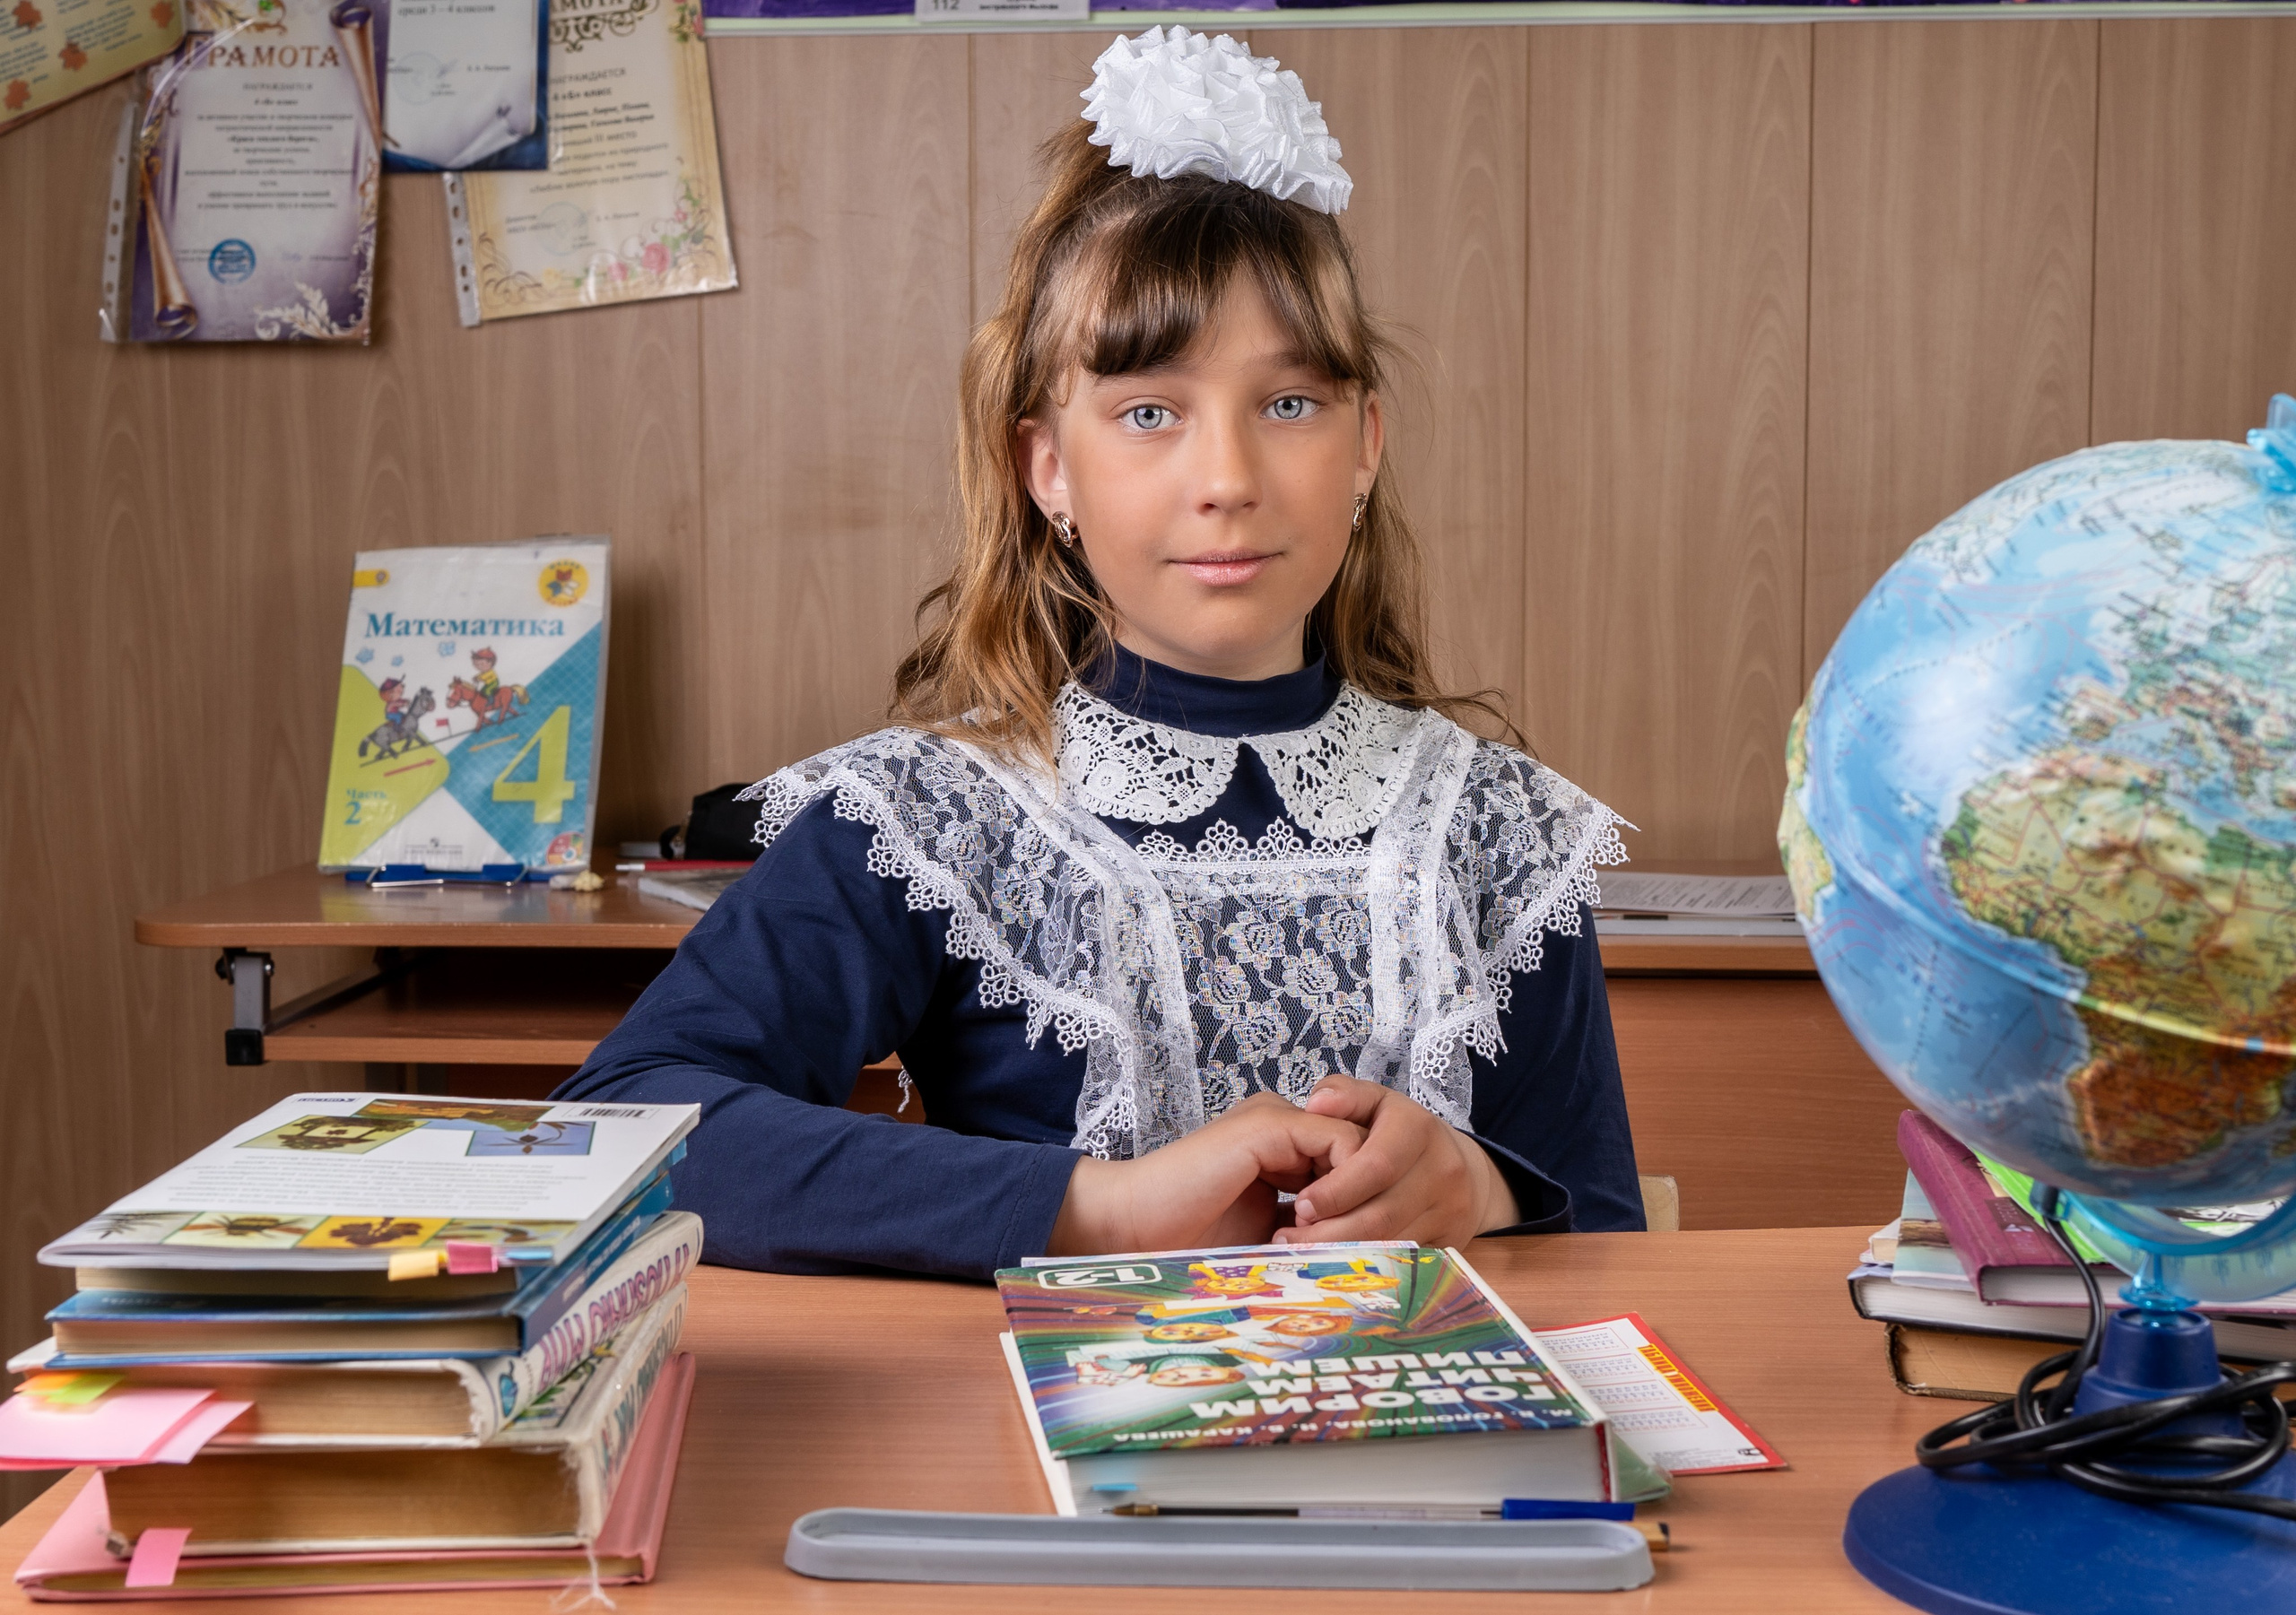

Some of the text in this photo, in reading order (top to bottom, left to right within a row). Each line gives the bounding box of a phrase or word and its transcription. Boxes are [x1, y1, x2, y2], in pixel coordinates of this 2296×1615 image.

[185, 34, 341, 68] ГРАМОТА
[365, 612, 565, 638] Математика
[491, 705, 576, 824] 4
[344, 801, 362, 826] 2
[1054, 1267, 1146, 1286] 1-2
[1248, 1350, 1526, 1378] ПИШЕМ
[1247, 1367, 1544, 1395] ЧИТАЕМ
[1188, 1385, 1557, 1419] ГОВОРИМ
[1540, 1408, 1574, 1418] М.
[1292, 1421, 1319, 1432] Н.
[1326, 1411, 1505, 1429] ГОЛОВАНОВА,
[1112, 1426, 1254, 1443] КАРАШЕВА
